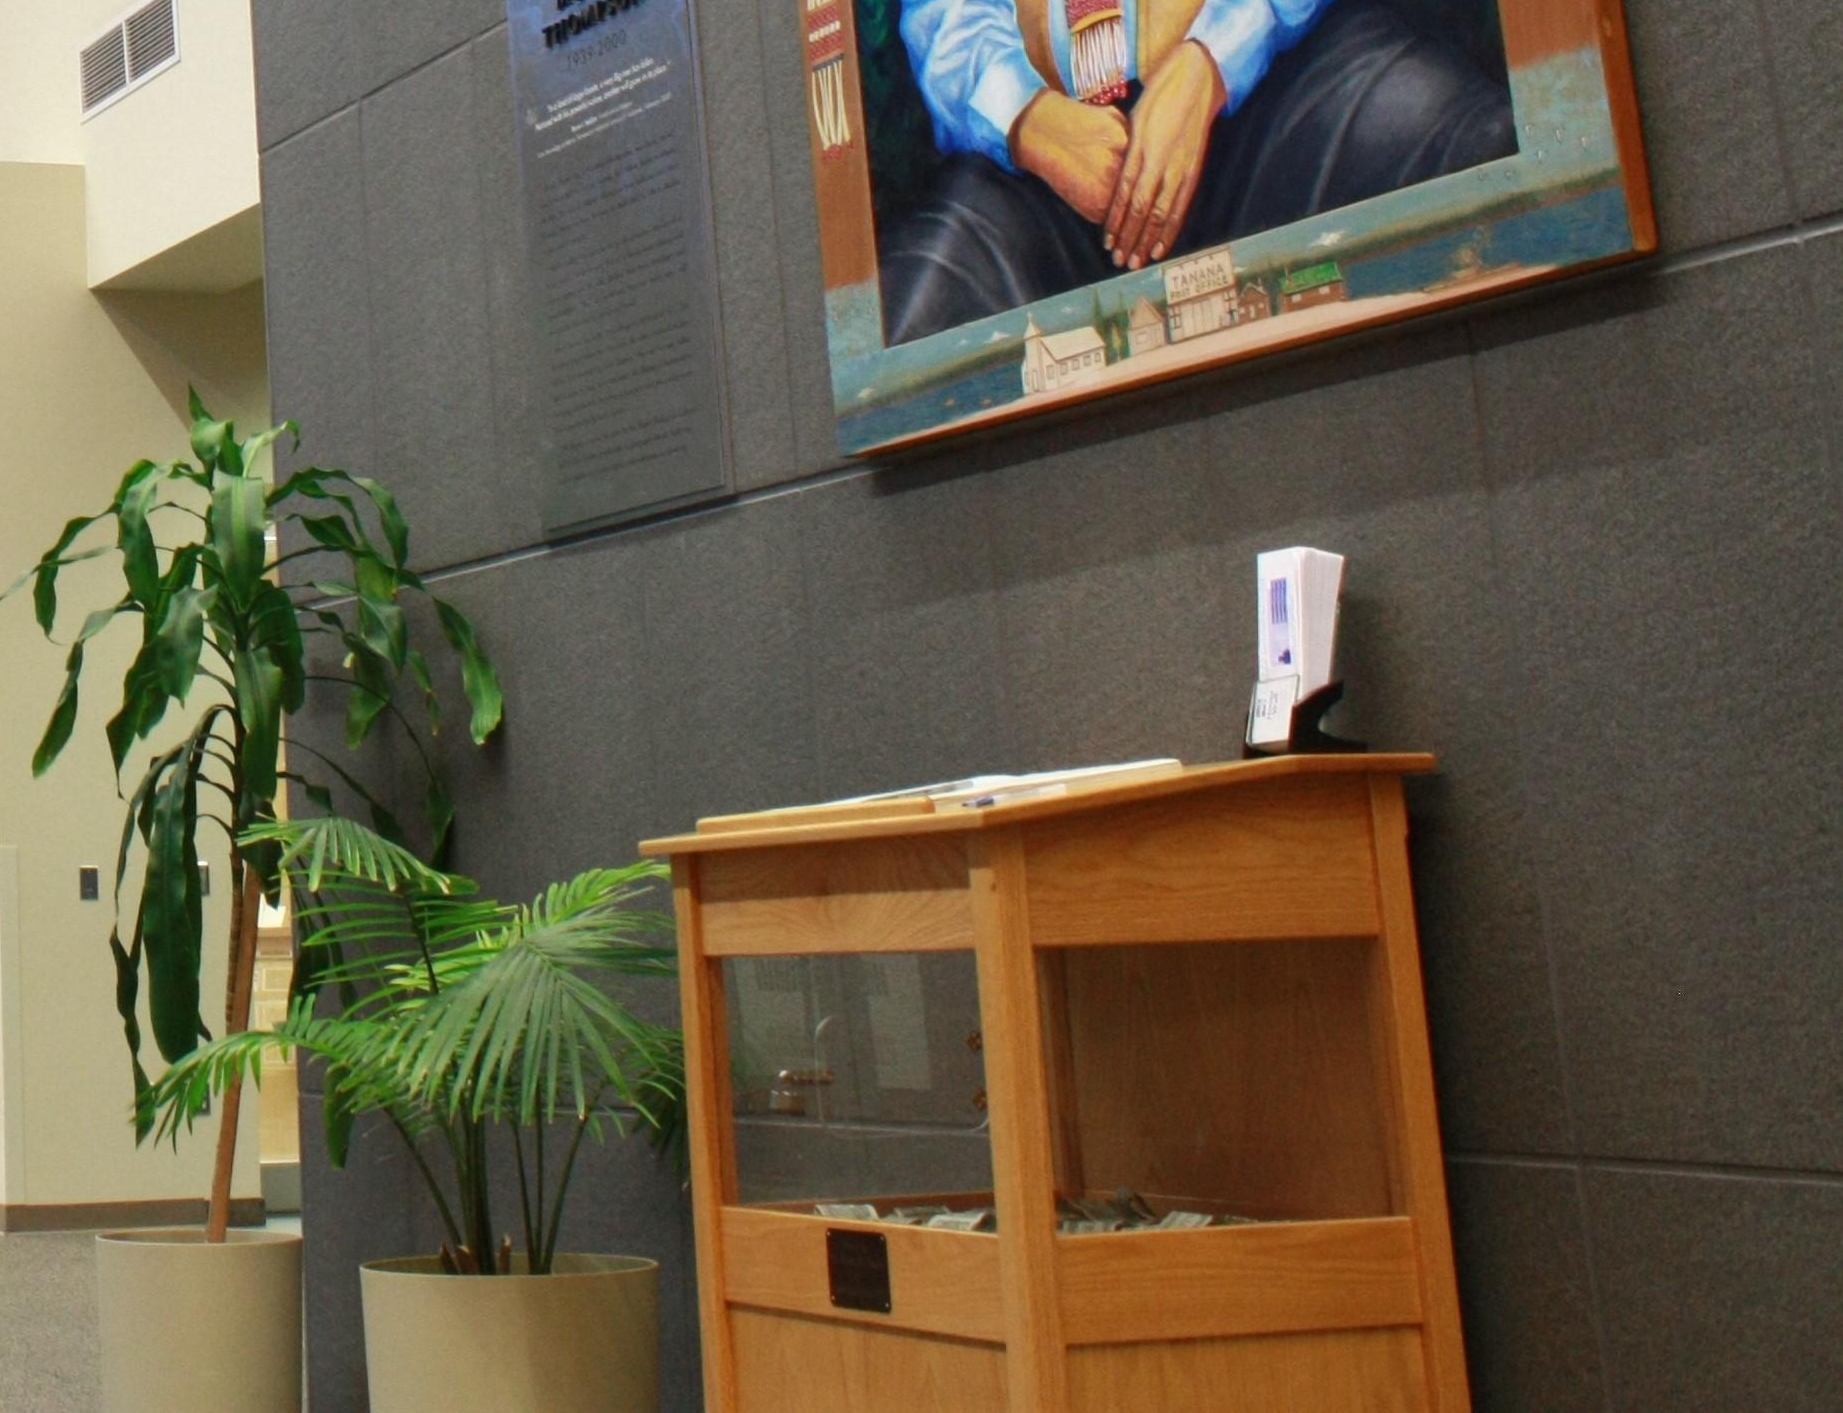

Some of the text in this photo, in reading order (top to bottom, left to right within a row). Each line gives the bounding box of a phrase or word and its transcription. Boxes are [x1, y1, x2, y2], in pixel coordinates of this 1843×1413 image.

[1170, 274, 1229, 300] POST OFFICE
[1171, 264, 1225, 291] TANANA
